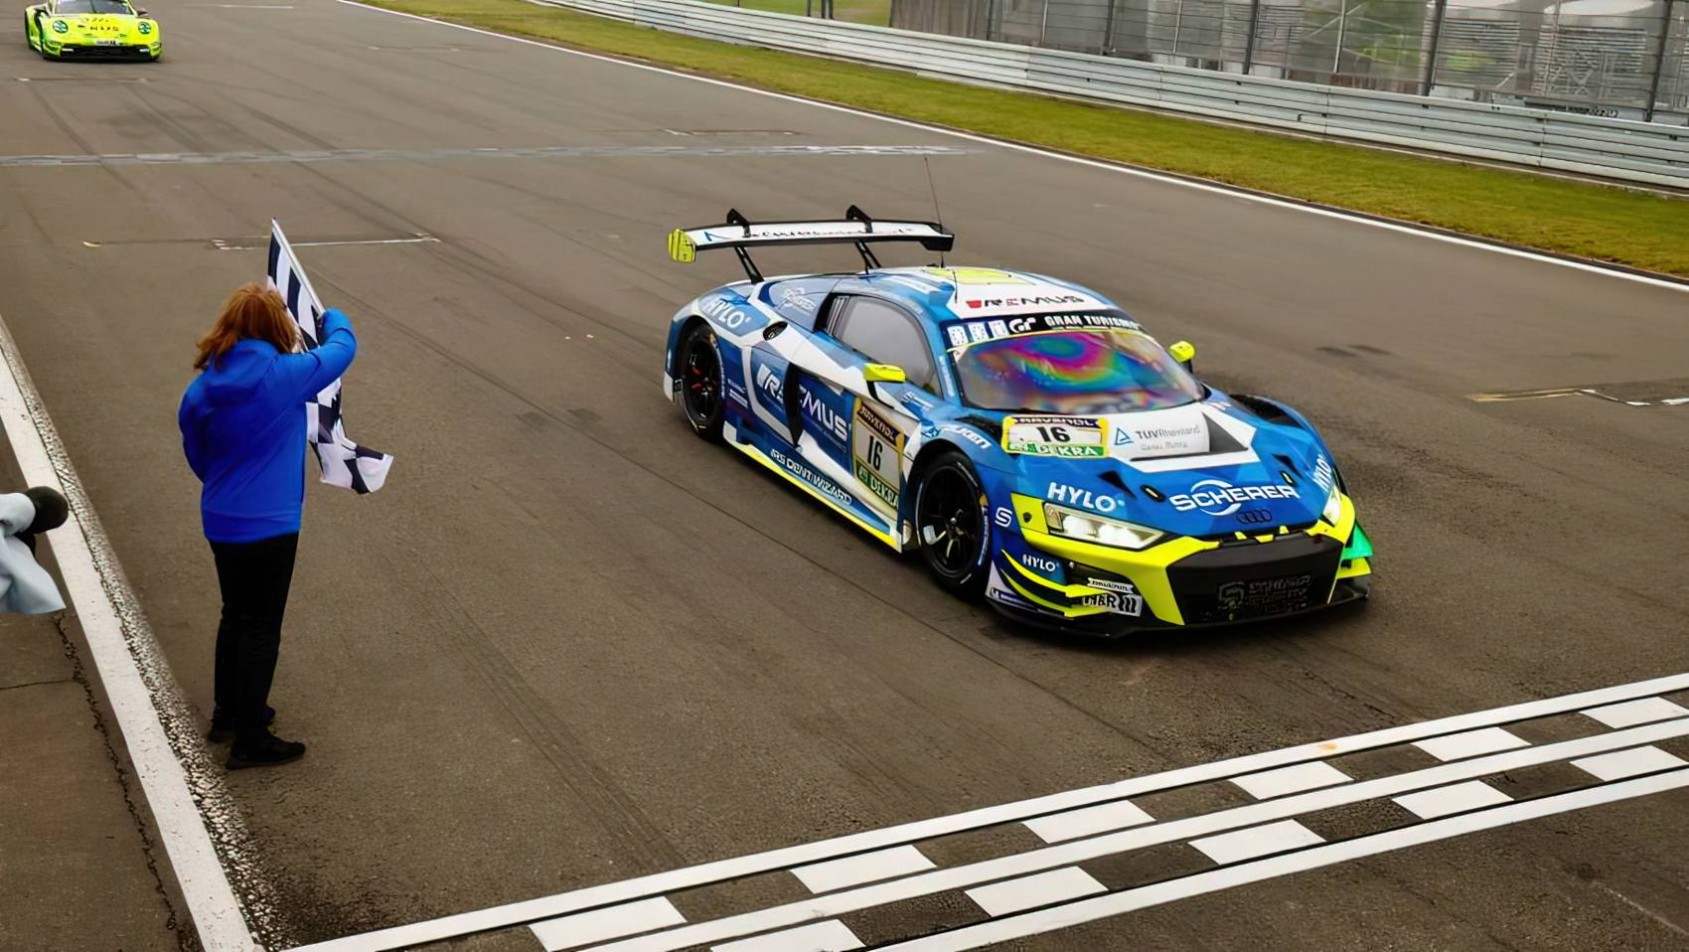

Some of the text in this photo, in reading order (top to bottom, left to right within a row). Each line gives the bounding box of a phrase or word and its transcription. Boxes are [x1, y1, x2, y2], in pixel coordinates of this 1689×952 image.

[984, 295, 1085, 308] REMUS
[703, 299, 745, 329] HYLO
[1044, 315, 1083, 327] GRAN
[1036, 426, 1071, 443] 16
[867, 435, 883, 471] 16
[1047, 482, 1116, 512] HYLO
[1169, 484, 1299, 512] SCHERER
[1022, 553, 1056, 572] HYLO
